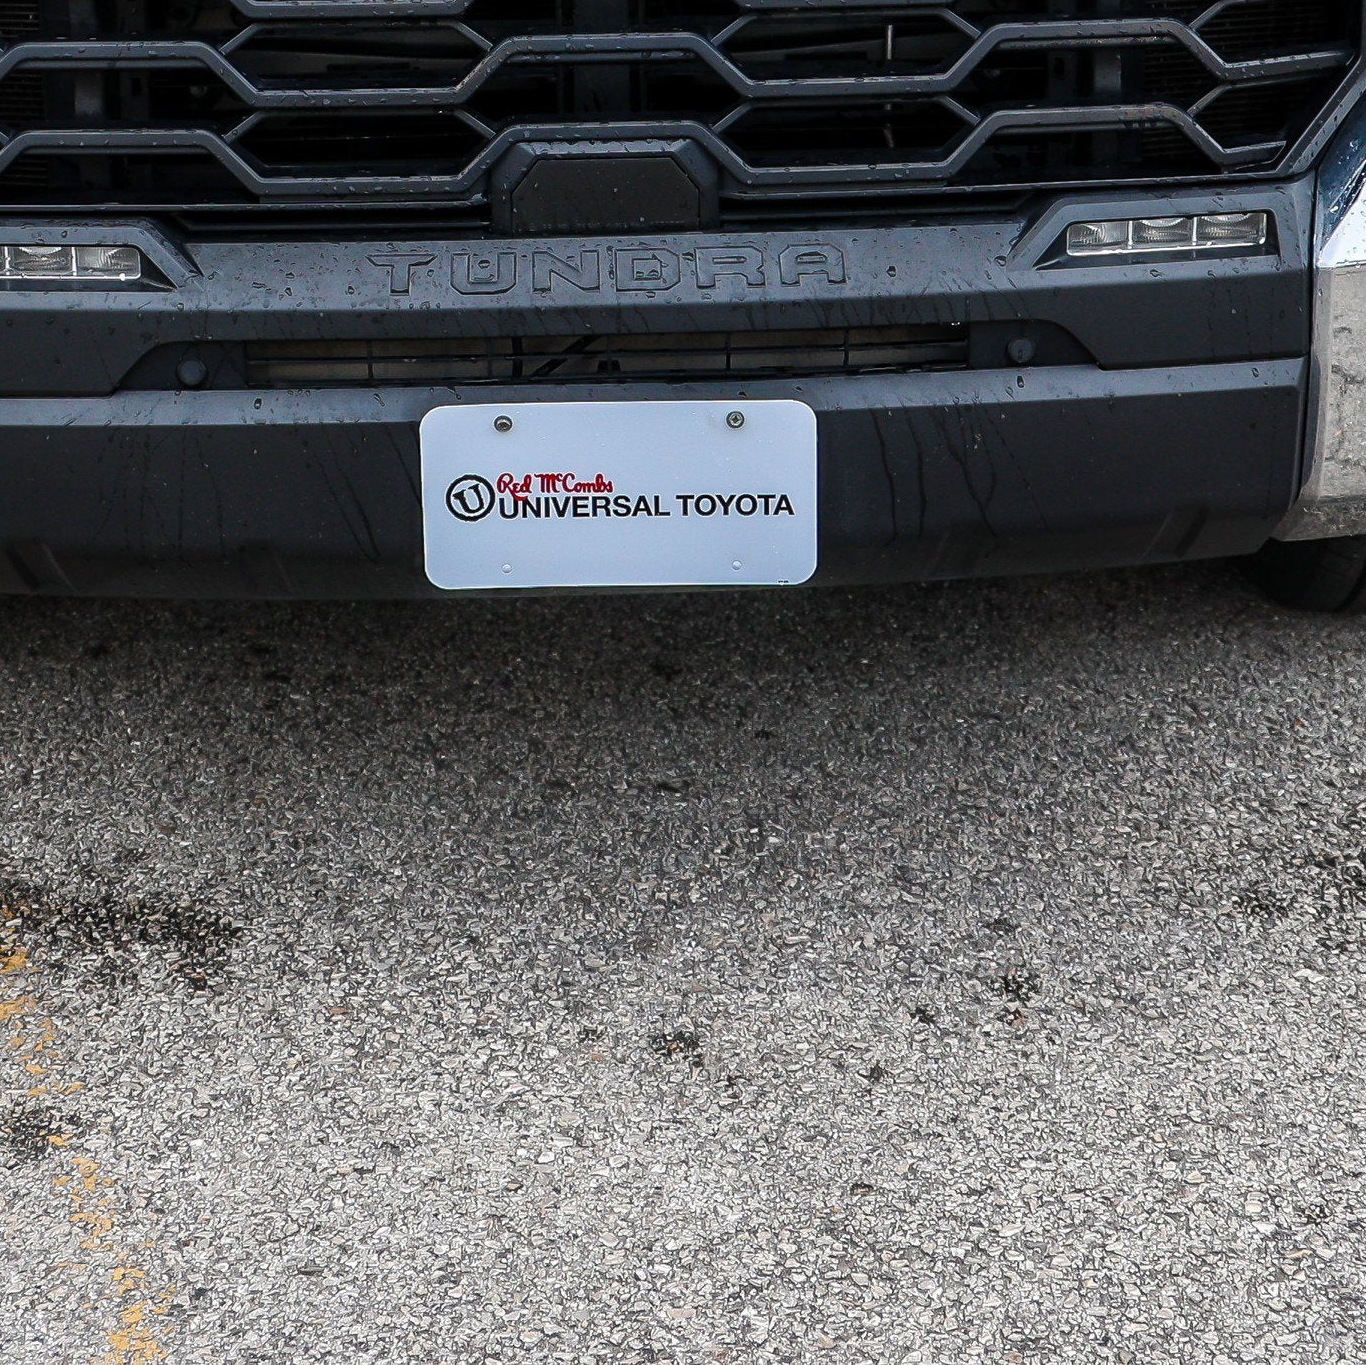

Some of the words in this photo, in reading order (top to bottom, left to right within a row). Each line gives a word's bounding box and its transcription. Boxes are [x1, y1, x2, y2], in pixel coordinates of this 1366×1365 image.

[366, 243, 847, 296] TUNDRA
[496, 472, 533, 501] Red
[534, 472, 614, 494] McCombs
[499, 495, 670, 520] UNIVERSAL
[676, 493, 795, 518] TOYOTA
